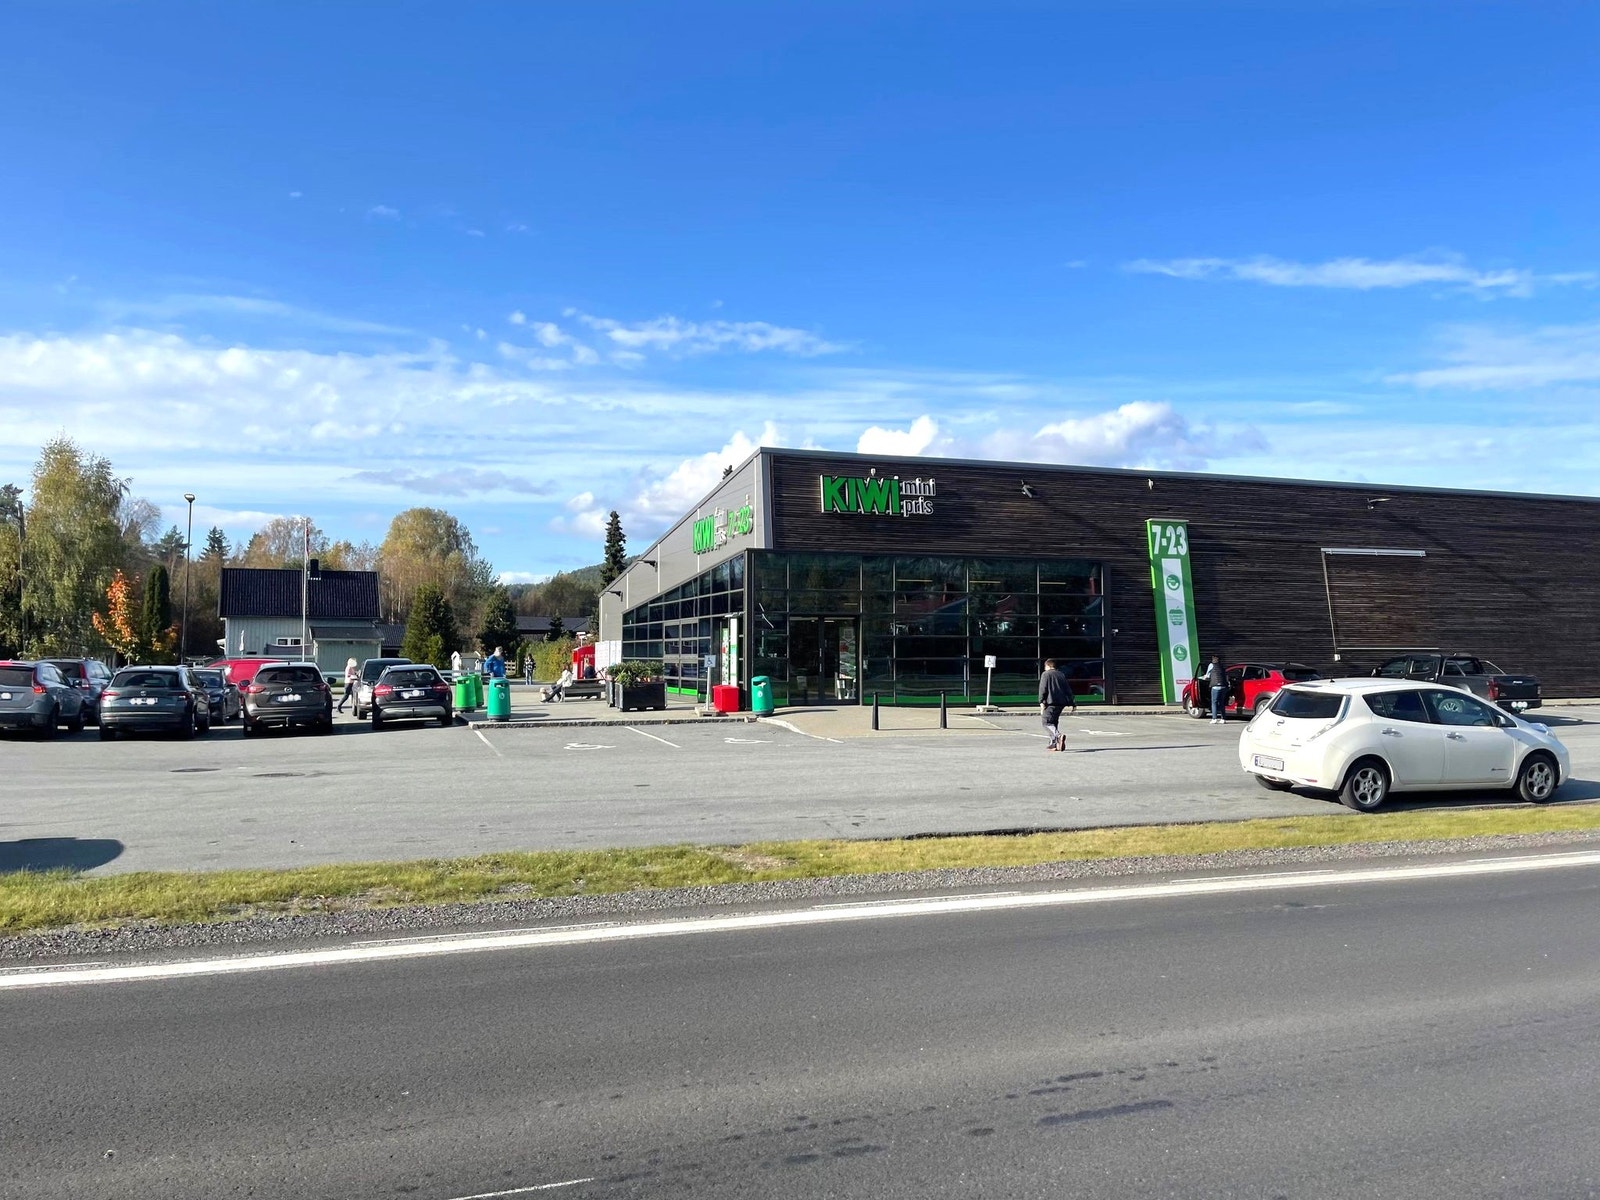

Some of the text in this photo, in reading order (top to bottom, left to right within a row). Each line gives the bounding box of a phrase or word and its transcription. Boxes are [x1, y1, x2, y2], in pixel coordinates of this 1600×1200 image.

[821, 475, 901, 515] KIWI
[902, 478, 936, 496] mini
[903, 496, 934, 517] pris
[693, 514, 714, 554] KIWI
[1151, 525, 1187, 556] 7-23
